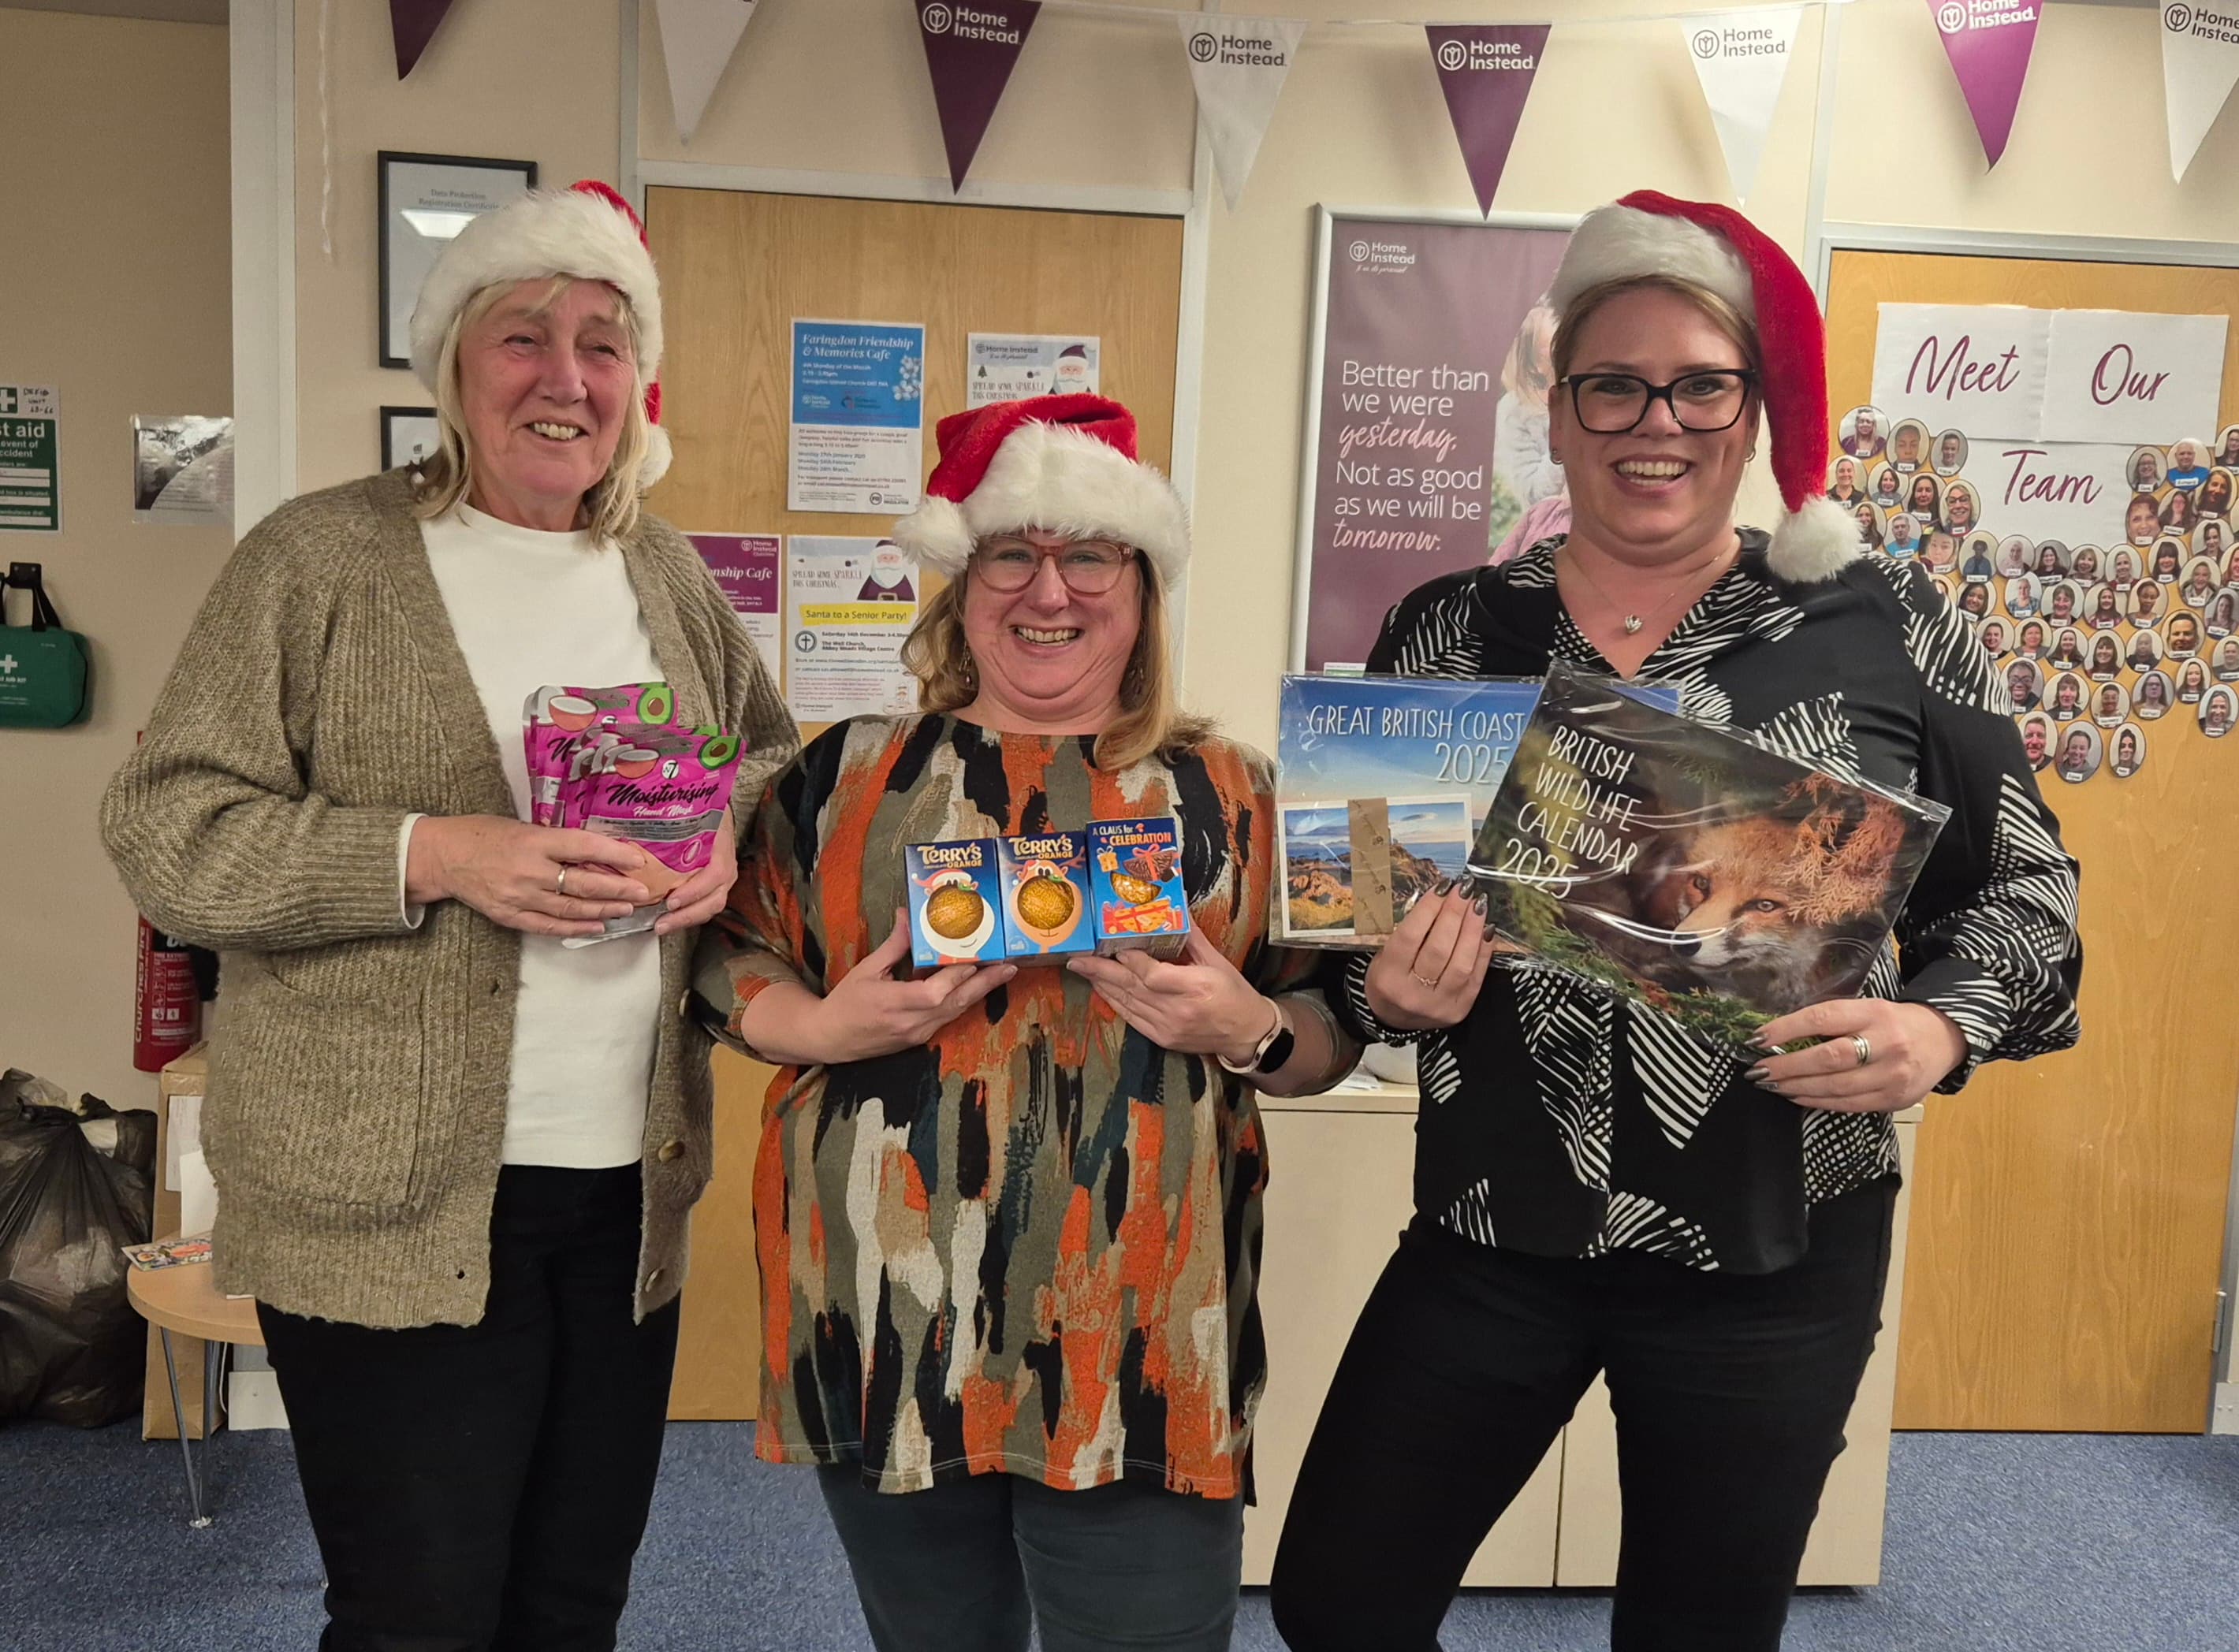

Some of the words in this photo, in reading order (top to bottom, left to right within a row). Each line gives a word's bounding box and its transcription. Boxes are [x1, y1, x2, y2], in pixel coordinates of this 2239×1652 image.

[956, 6, 1008, 28] Home
[1970, 0, 2020, 14] Home
[1970, 8, 2033, 29] Instead
[2196, 8, 2239, 31] Home
[954, 24, 1019, 45] Instead
[1221, 34, 1272, 51] Home
[1724, 28, 1773, 42] Home
[2191, 23, 2239, 45] Instea
[1220, 50, 1284, 66] Instead
[1471, 39, 1521, 56] Home
[1723, 41, 1786, 58] Instead
[1470, 55, 1533, 71] Instead
[1370, 252, 1415, 265] Instead
[1371, 242, 1407, 255] Home
[803, 333, 857, 347] Faringdon
[859, 336, 914, 351] Friendship
[803, 347, 812, 356] &
[814, 348, 865, 359] Memories
[1343, 360, 1422, 388] Better
[1432, 364, 1489, 392] than
[1906, 334, 2020, 402] Meet
[2091, 343, 2171, 406] Our
[1343, 393, 1380, 414] we
[1389, 395, 1454, 417] were
[16, 422, 45, 437] aid
[1339, 415, 1458, 463] yesterday,
[0, 440, 27, 448] event
[29, 440, 39, 448] of
[1336, 461, 1380, 486] Not
[1387, 468, 1414, 487] as
[1420, 466, 1483, 494] good
[2002, 449, 2103, 505] Team
[1335, 498, 1360, 515] as
[1367, 498, 1401, 517] we
[1407, 495, 1444, 519] will
[1451, 497, 1482, 520] be
[1332, 517, 1441, 551] tomorrow.
[806, 610, 830, 619] Santa
[851, 611, 879, 620] Senior
[881, 611, 907, 620] Party!
[1309, 705, 1373, 736] GREAT
[1381, 707, 1454, 739] BRITISH
[1435, 743, 1512, 784] 2025
[1549, 726, 1636, 785] BRITISH
[606, 783, 719, 806] Moisturising
[1534, 761, 1641, 832] WILDLIFE
[632, 806, 664, 817] Hand
[666, 805, 695, 817] Mask
[1099, 824, 1123, 835] CLAUS
[1123, 824, 1134, 833] for
[1110, 832, 1172, 846] CELEBRATION
[1517, 801, 1640, 876] CALENDAR
[917, 842, 982, 865] TERRY'S
[1008, 834, 1073, 857] TERRY'S
[1038, 850, 1074, 859] ORANGE
[947, 859, 982, 869] ORANGE
[1499, 838, 1579, 899] 2025
[135, 964, 145, 1043] Churches
